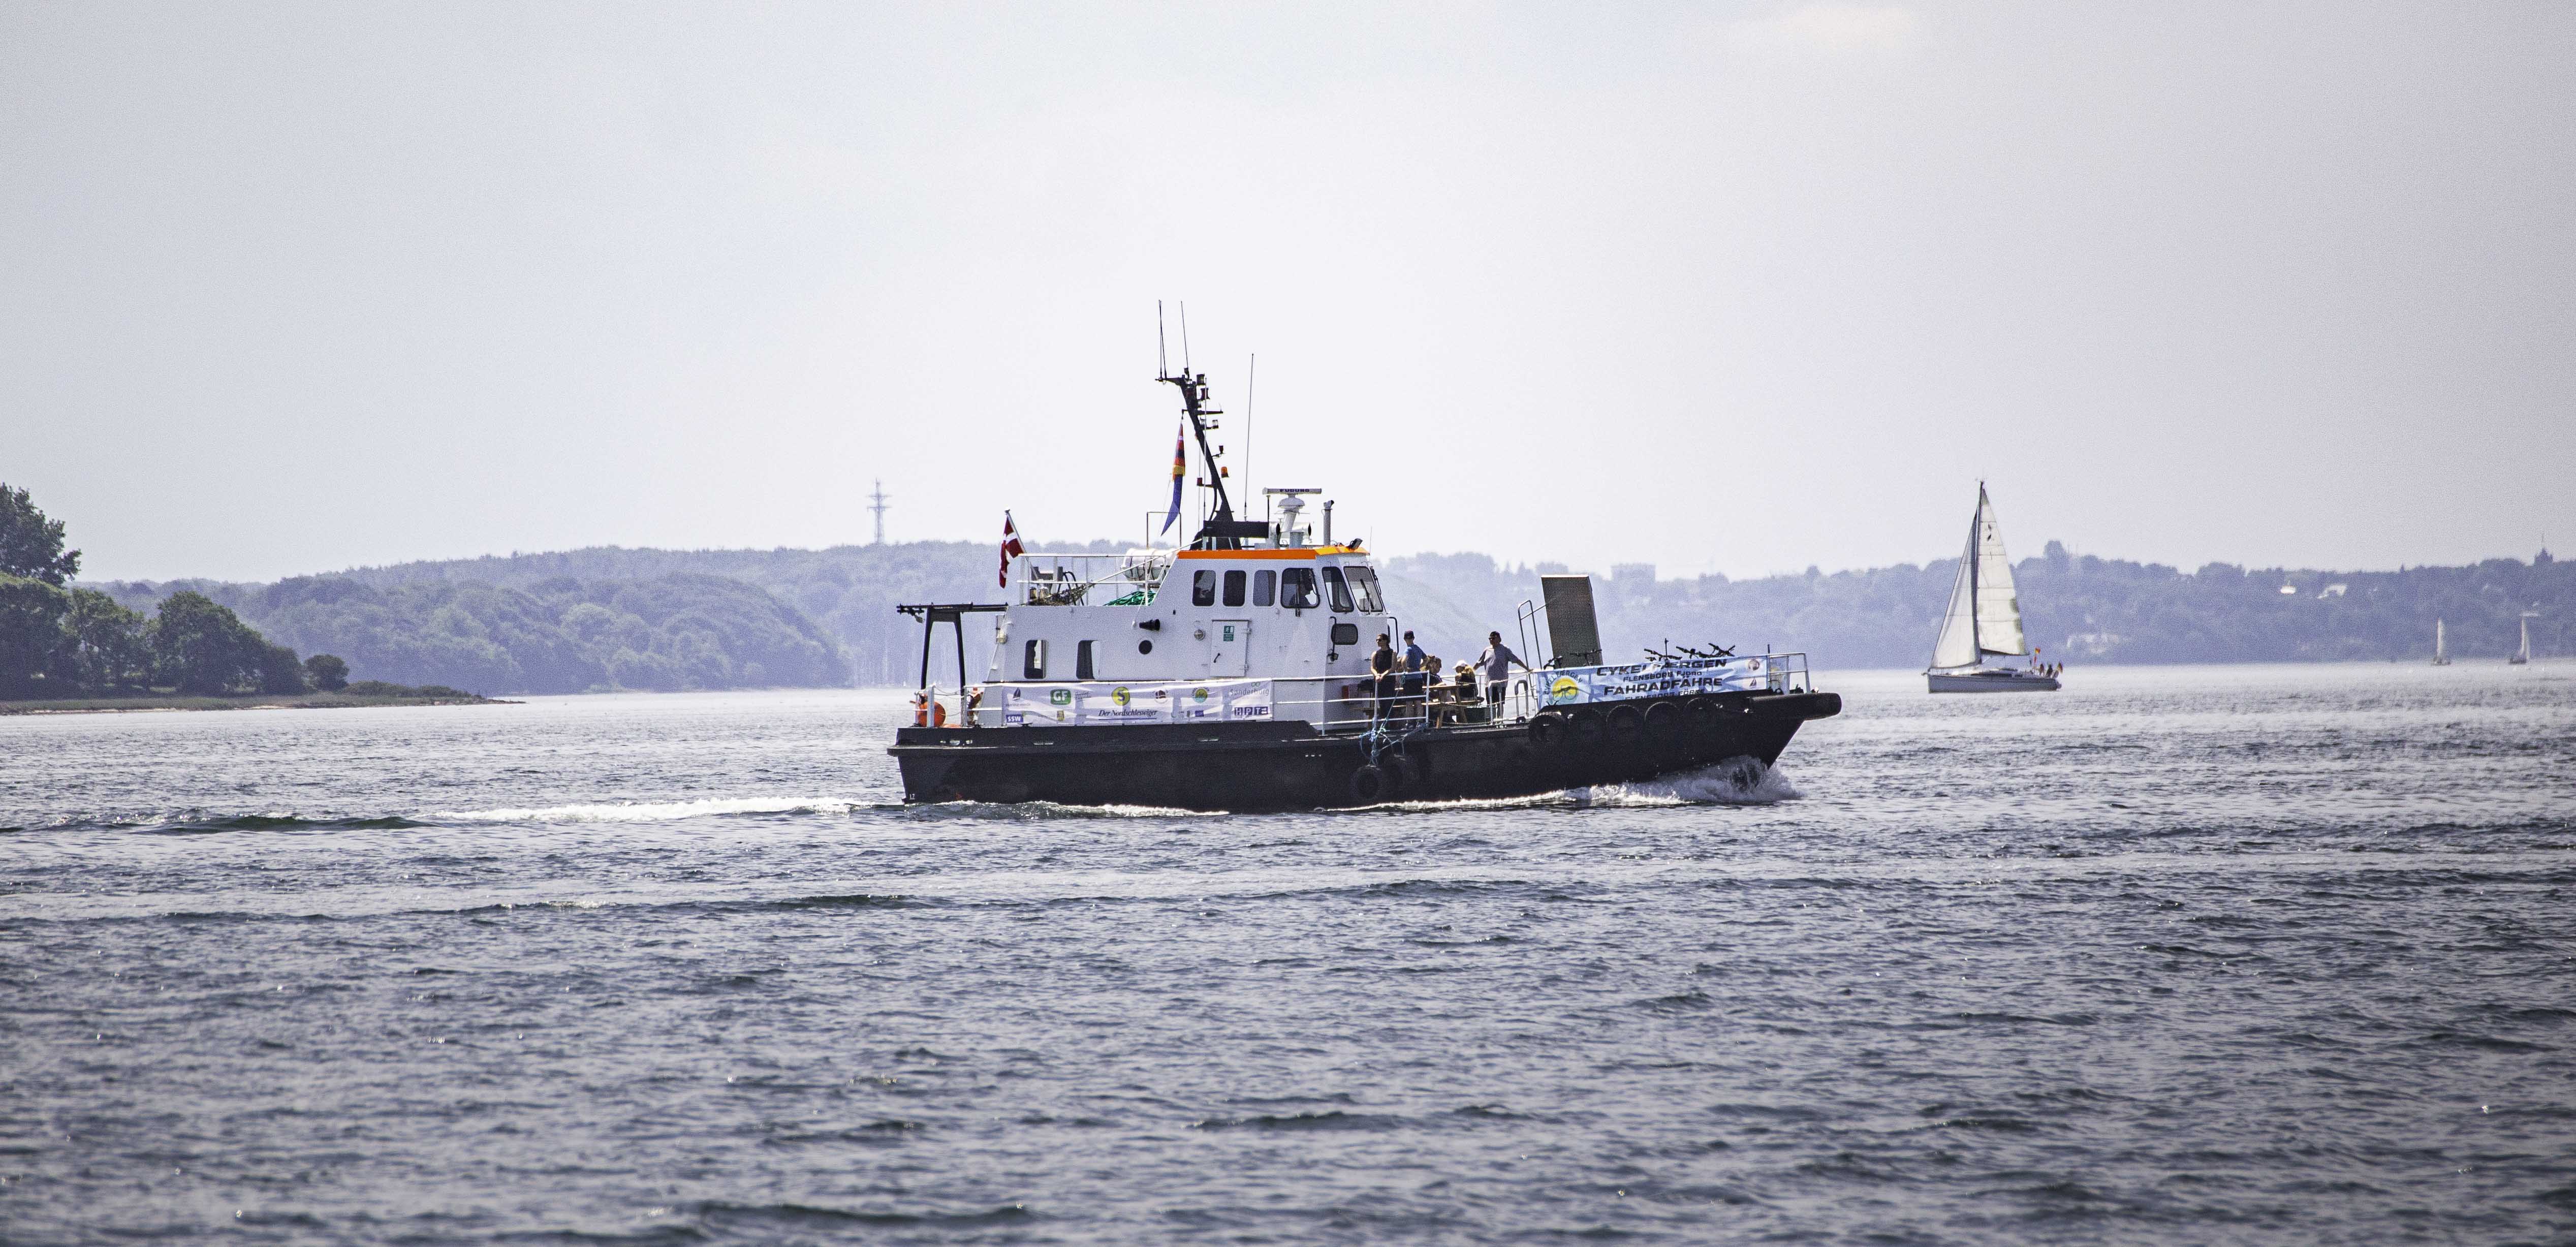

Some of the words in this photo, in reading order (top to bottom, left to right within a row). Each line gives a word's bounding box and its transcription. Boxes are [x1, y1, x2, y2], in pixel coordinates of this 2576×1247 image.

[1597, 659, 1727, 676] CYKEÆRGEN
[1053, 691, 1068, 701] GF
[1111, 709, 1157, 717] Nordschleswiger
